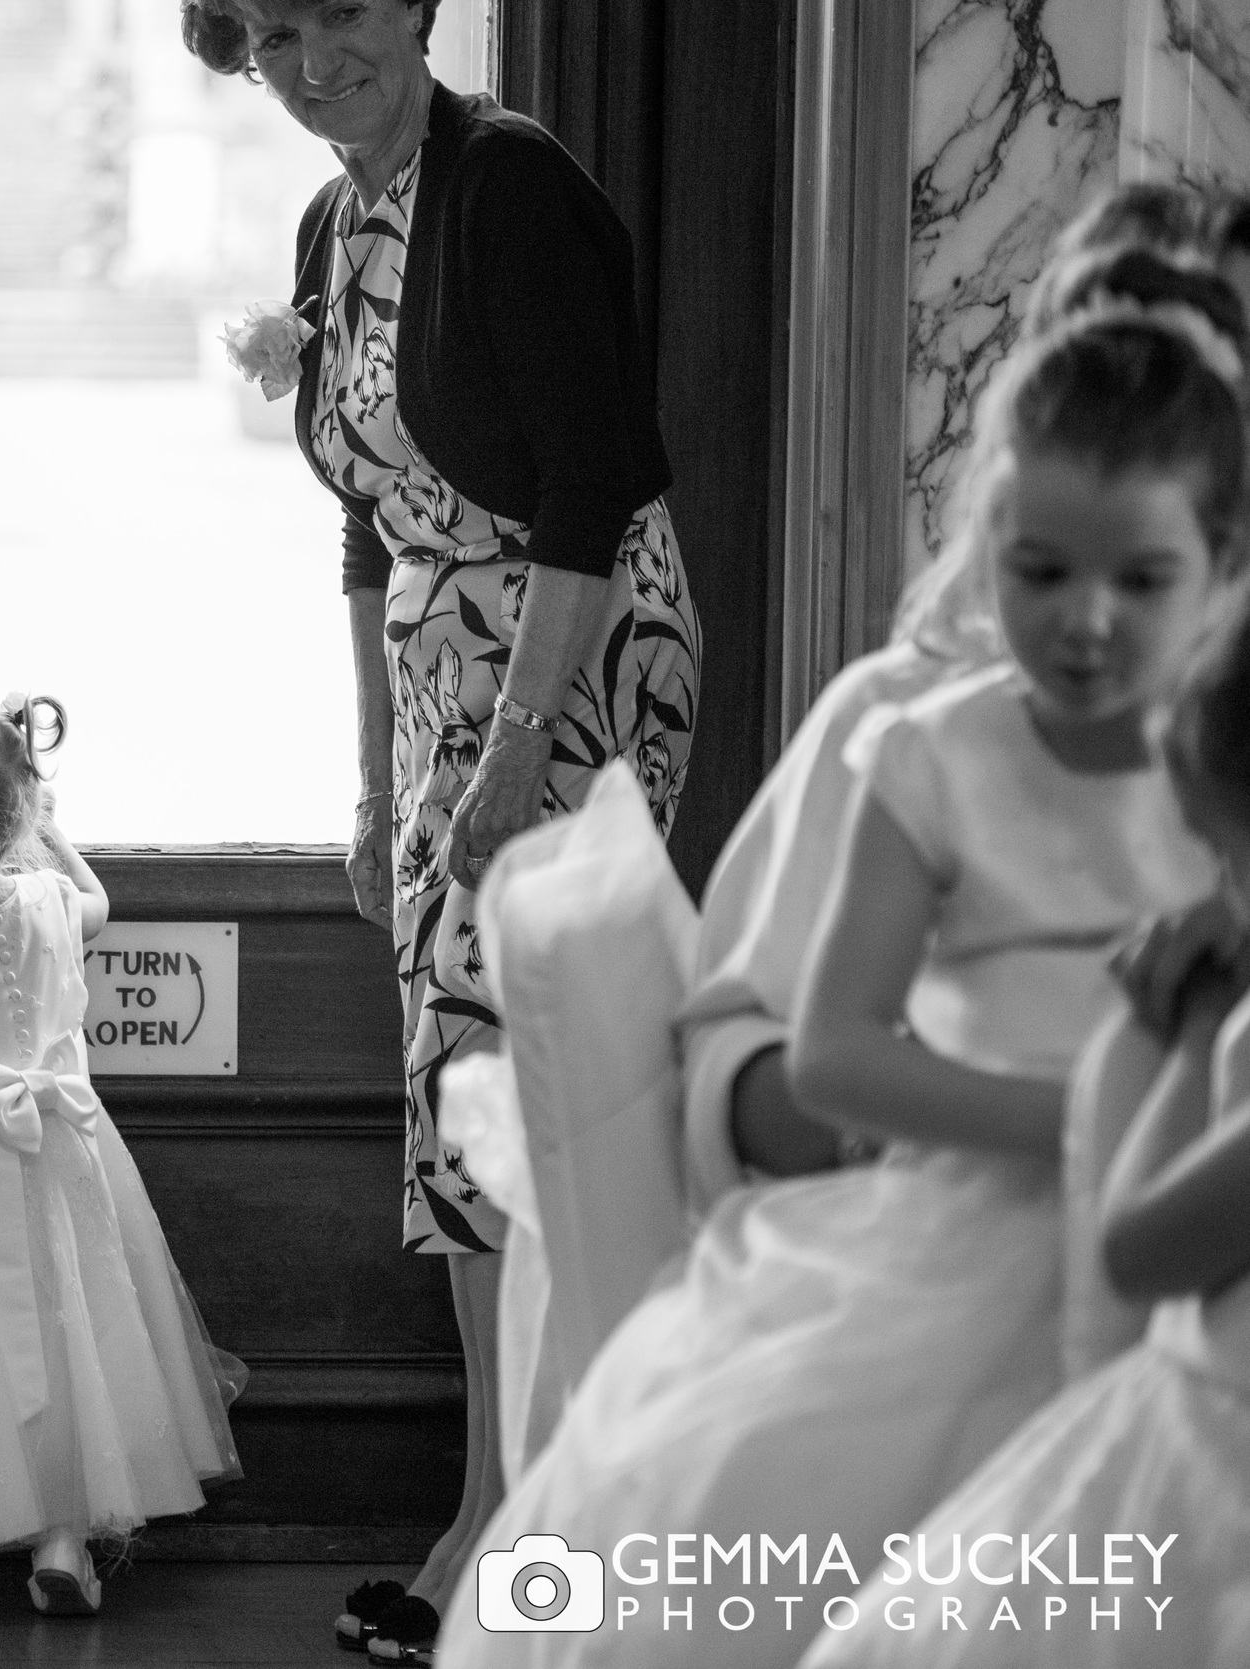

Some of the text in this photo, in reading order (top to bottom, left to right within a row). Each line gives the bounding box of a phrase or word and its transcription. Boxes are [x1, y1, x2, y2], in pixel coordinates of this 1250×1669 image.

[97, 950, 181, 976] TURN
[115, 987, 157, 1008] TO
[95, 1020, 178, 1046] OPEN
